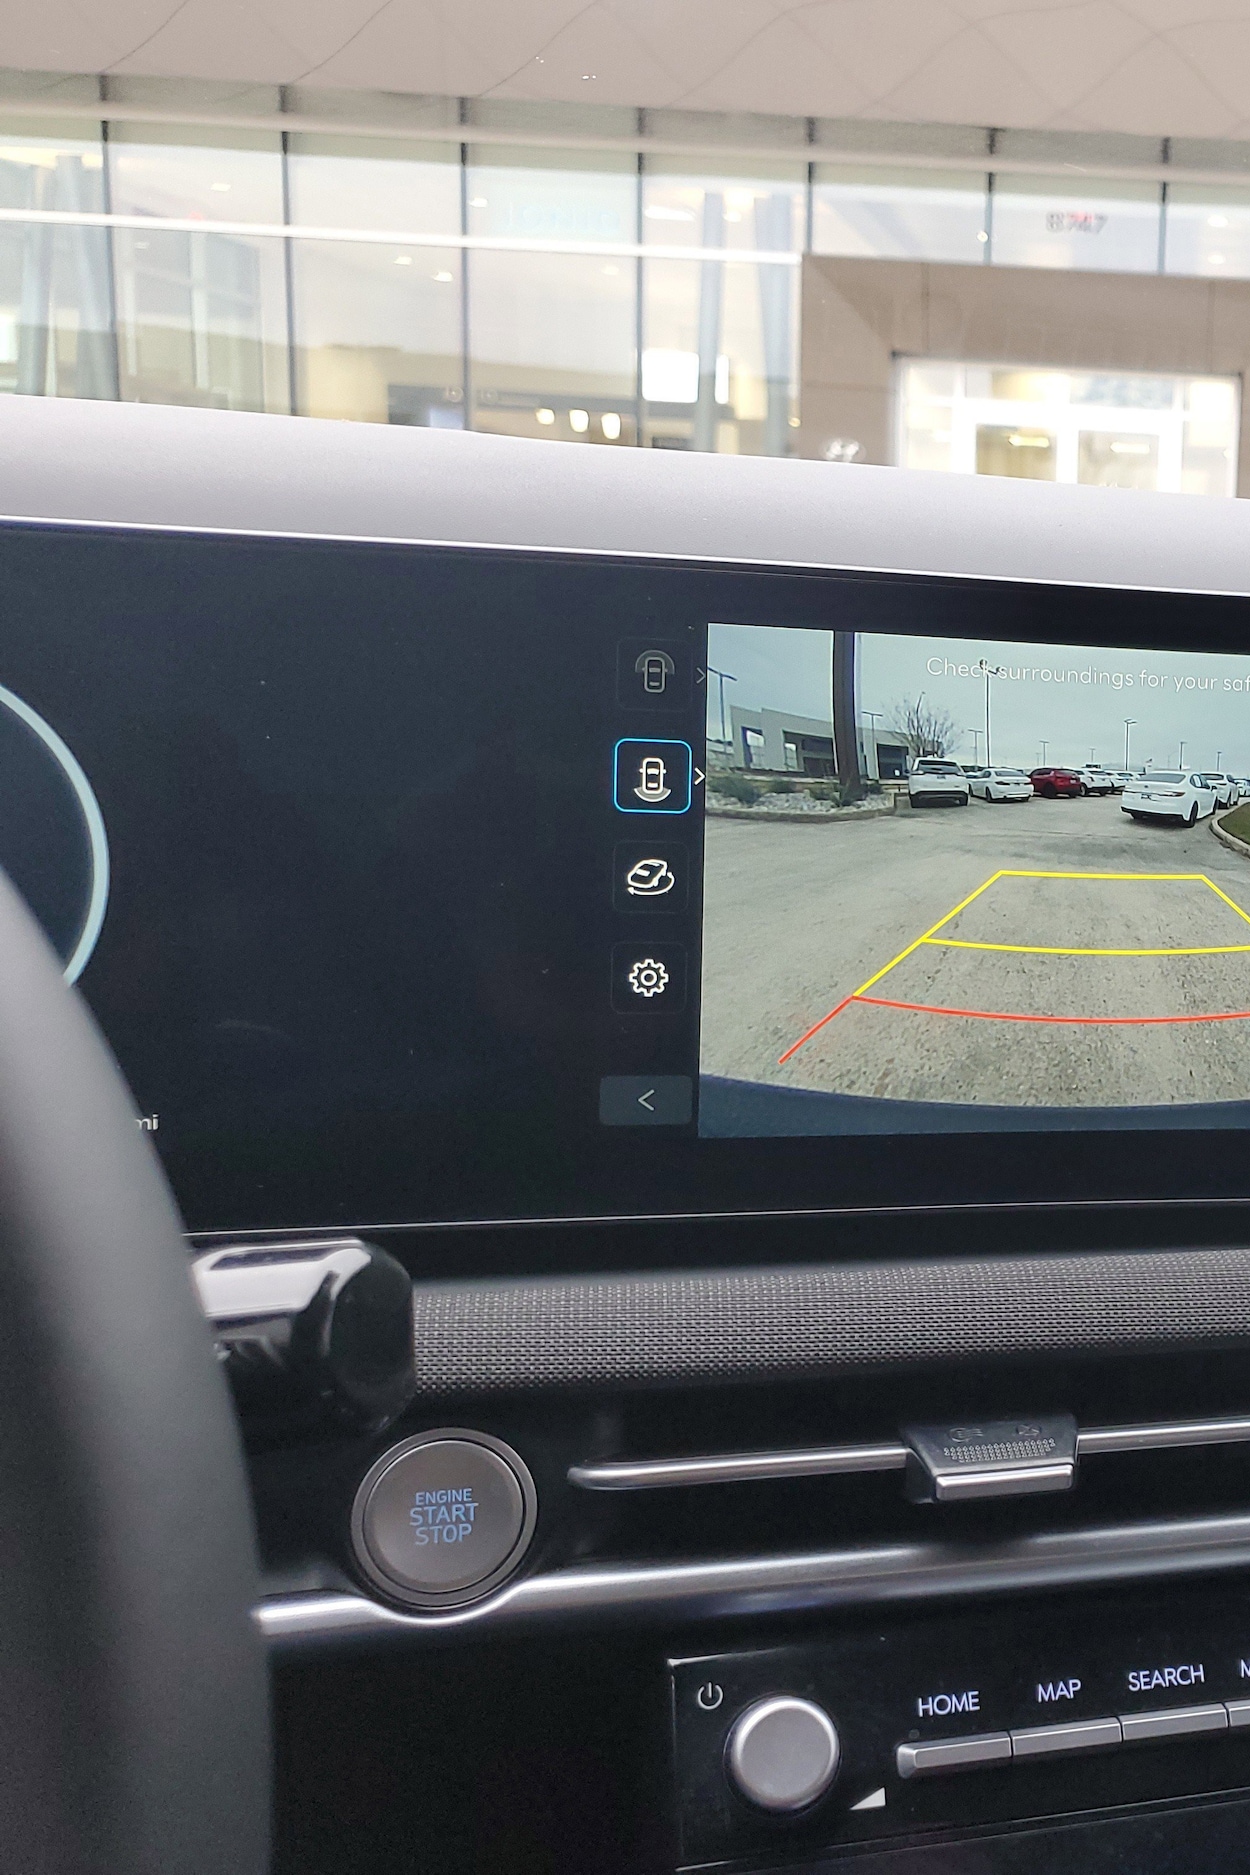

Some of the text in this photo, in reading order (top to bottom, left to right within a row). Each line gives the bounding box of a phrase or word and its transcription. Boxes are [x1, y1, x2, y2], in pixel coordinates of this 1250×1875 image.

[926, 657, 995, 679] Check
[998, 665, 1134, 690] surroundings
[1139, 670, 1167, 689] for
[1173, 674, 1218, 692] your
[416, 1487, 473, 1506] ENGINE
[409, 1502, 479, 1526] START
[415, 1523, 473, 1546] STOP
[1128, 1663, 1205, 1692] SEARCH
[1037, 1678, 1082, 1703] MAP
[917, 1690, 981, 1718] HOME
